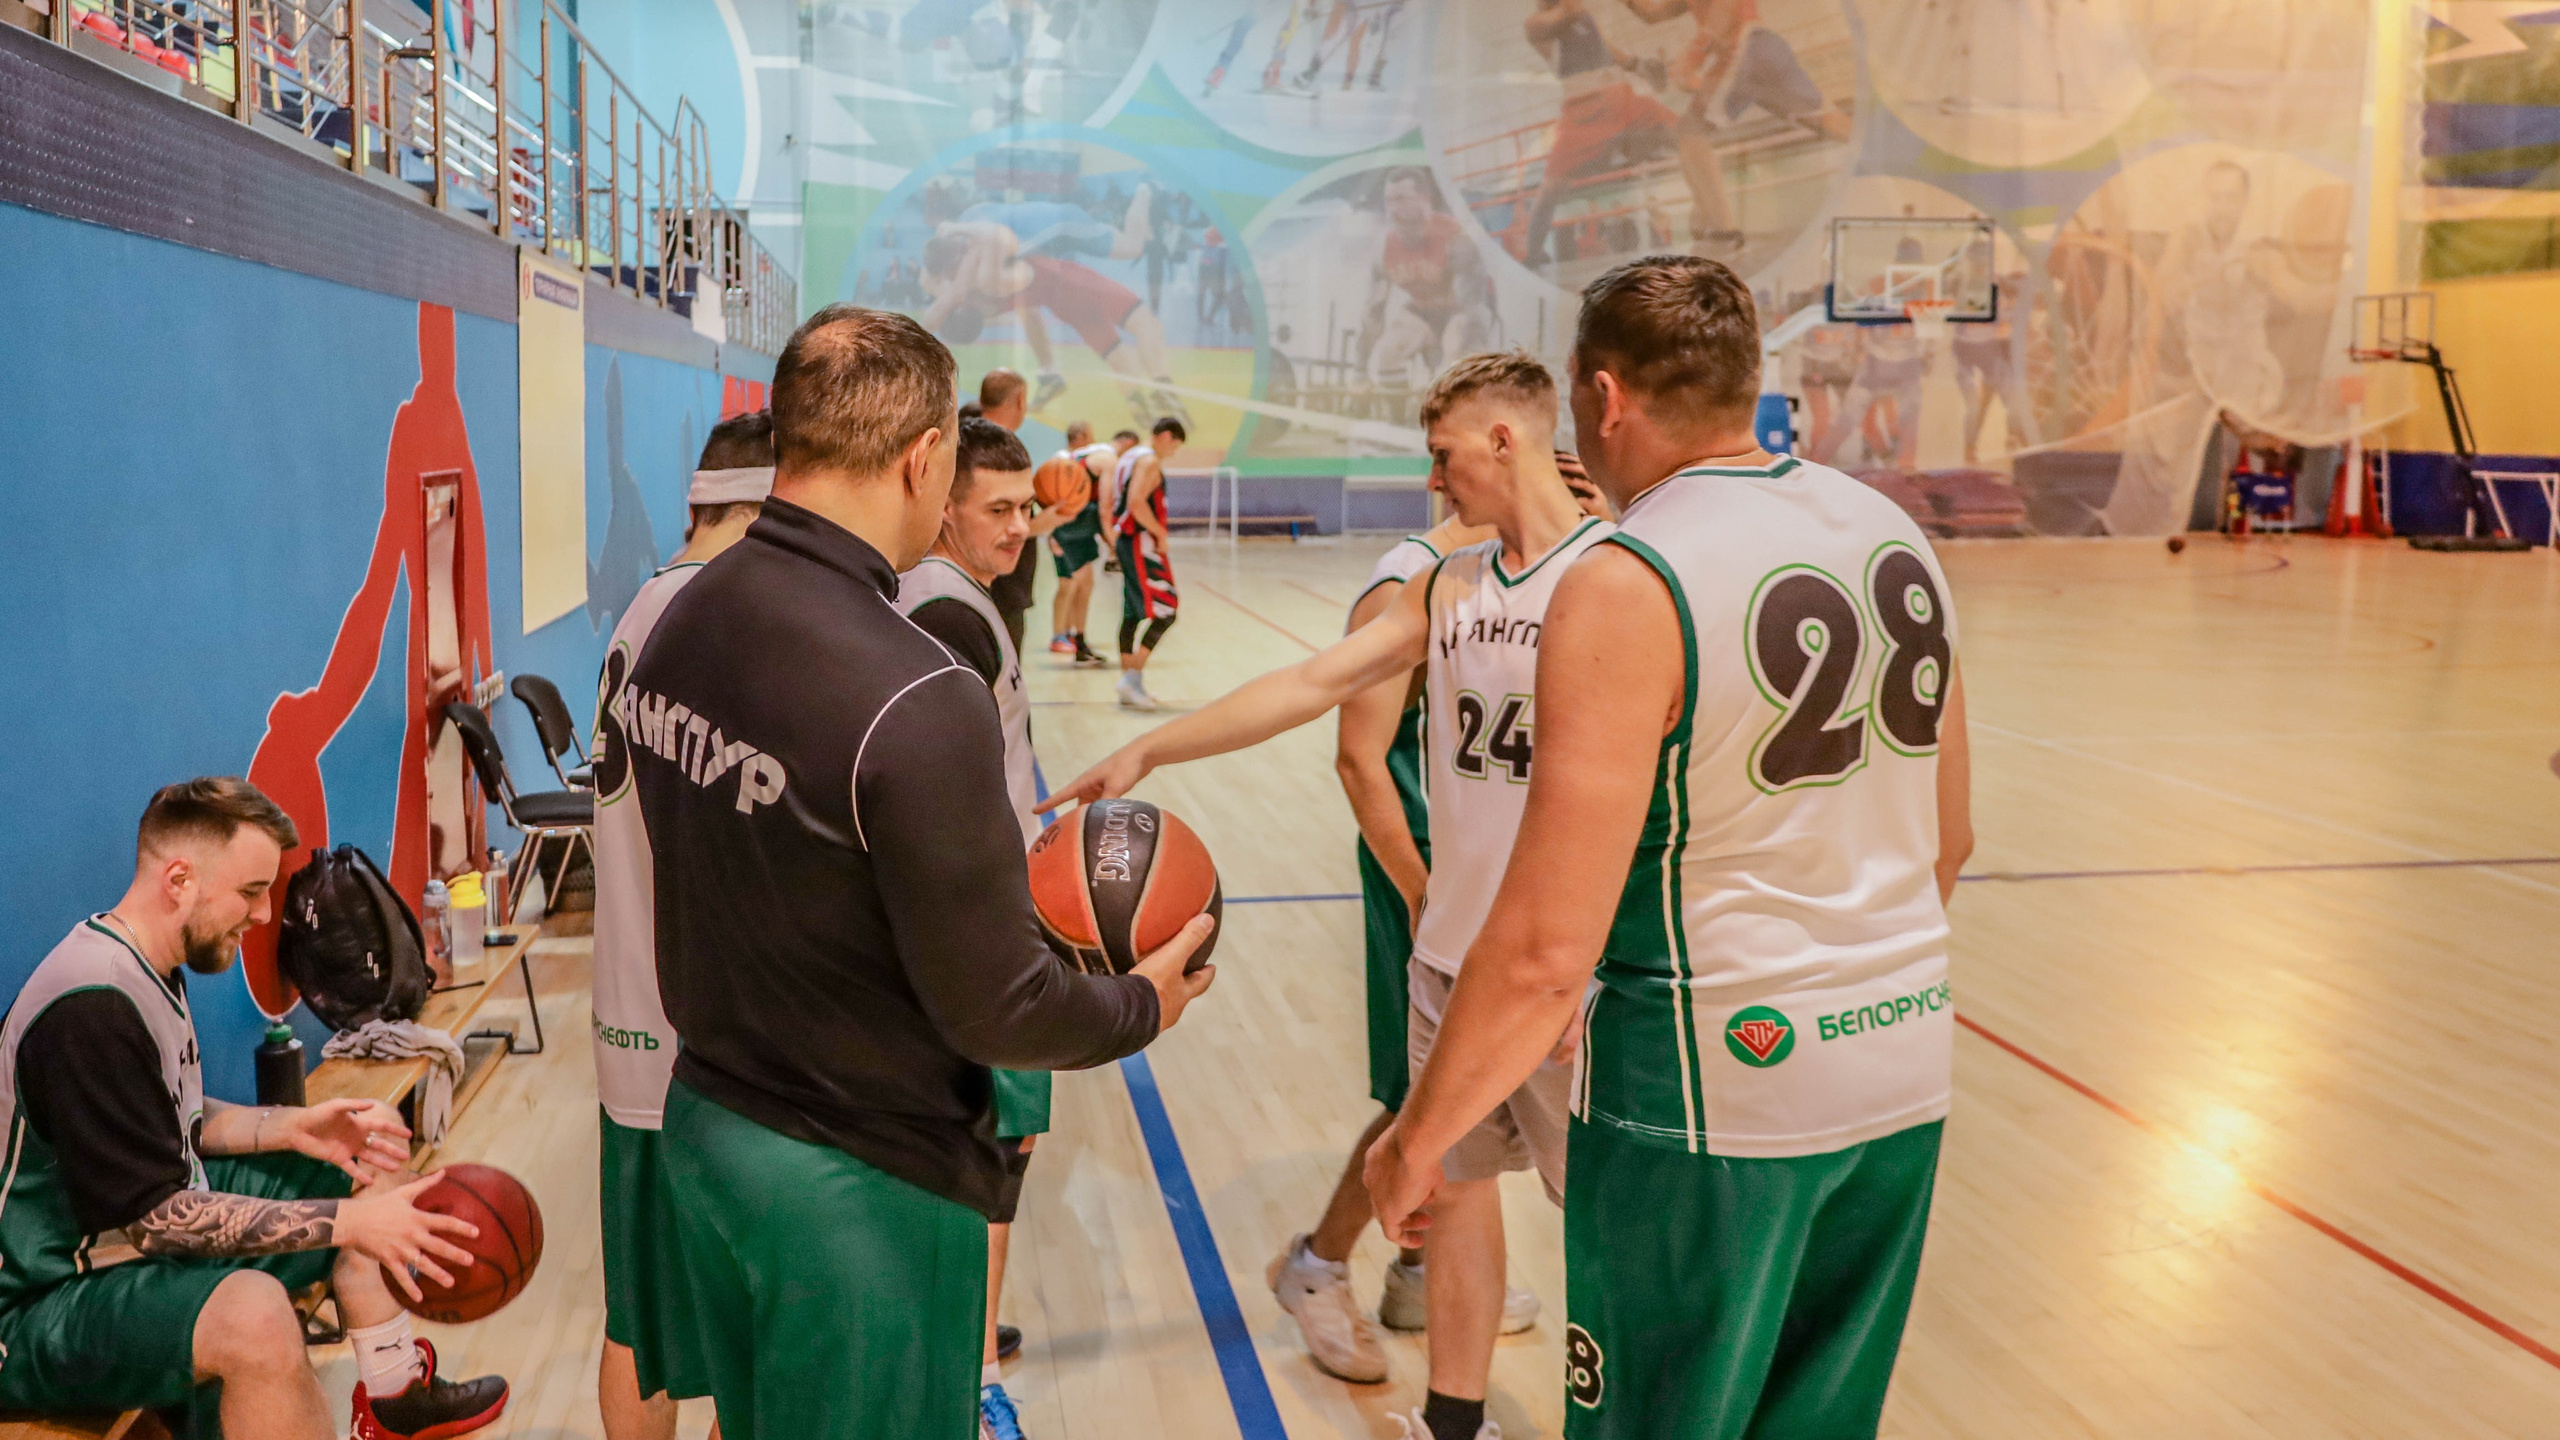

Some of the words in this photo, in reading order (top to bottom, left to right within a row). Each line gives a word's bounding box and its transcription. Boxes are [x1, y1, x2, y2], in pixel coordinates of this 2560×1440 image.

[1744, 540, 1951, 796] 28
[1452, 687, 1534, 785] 24
[1565, 1322, 1604, 1409] 8
